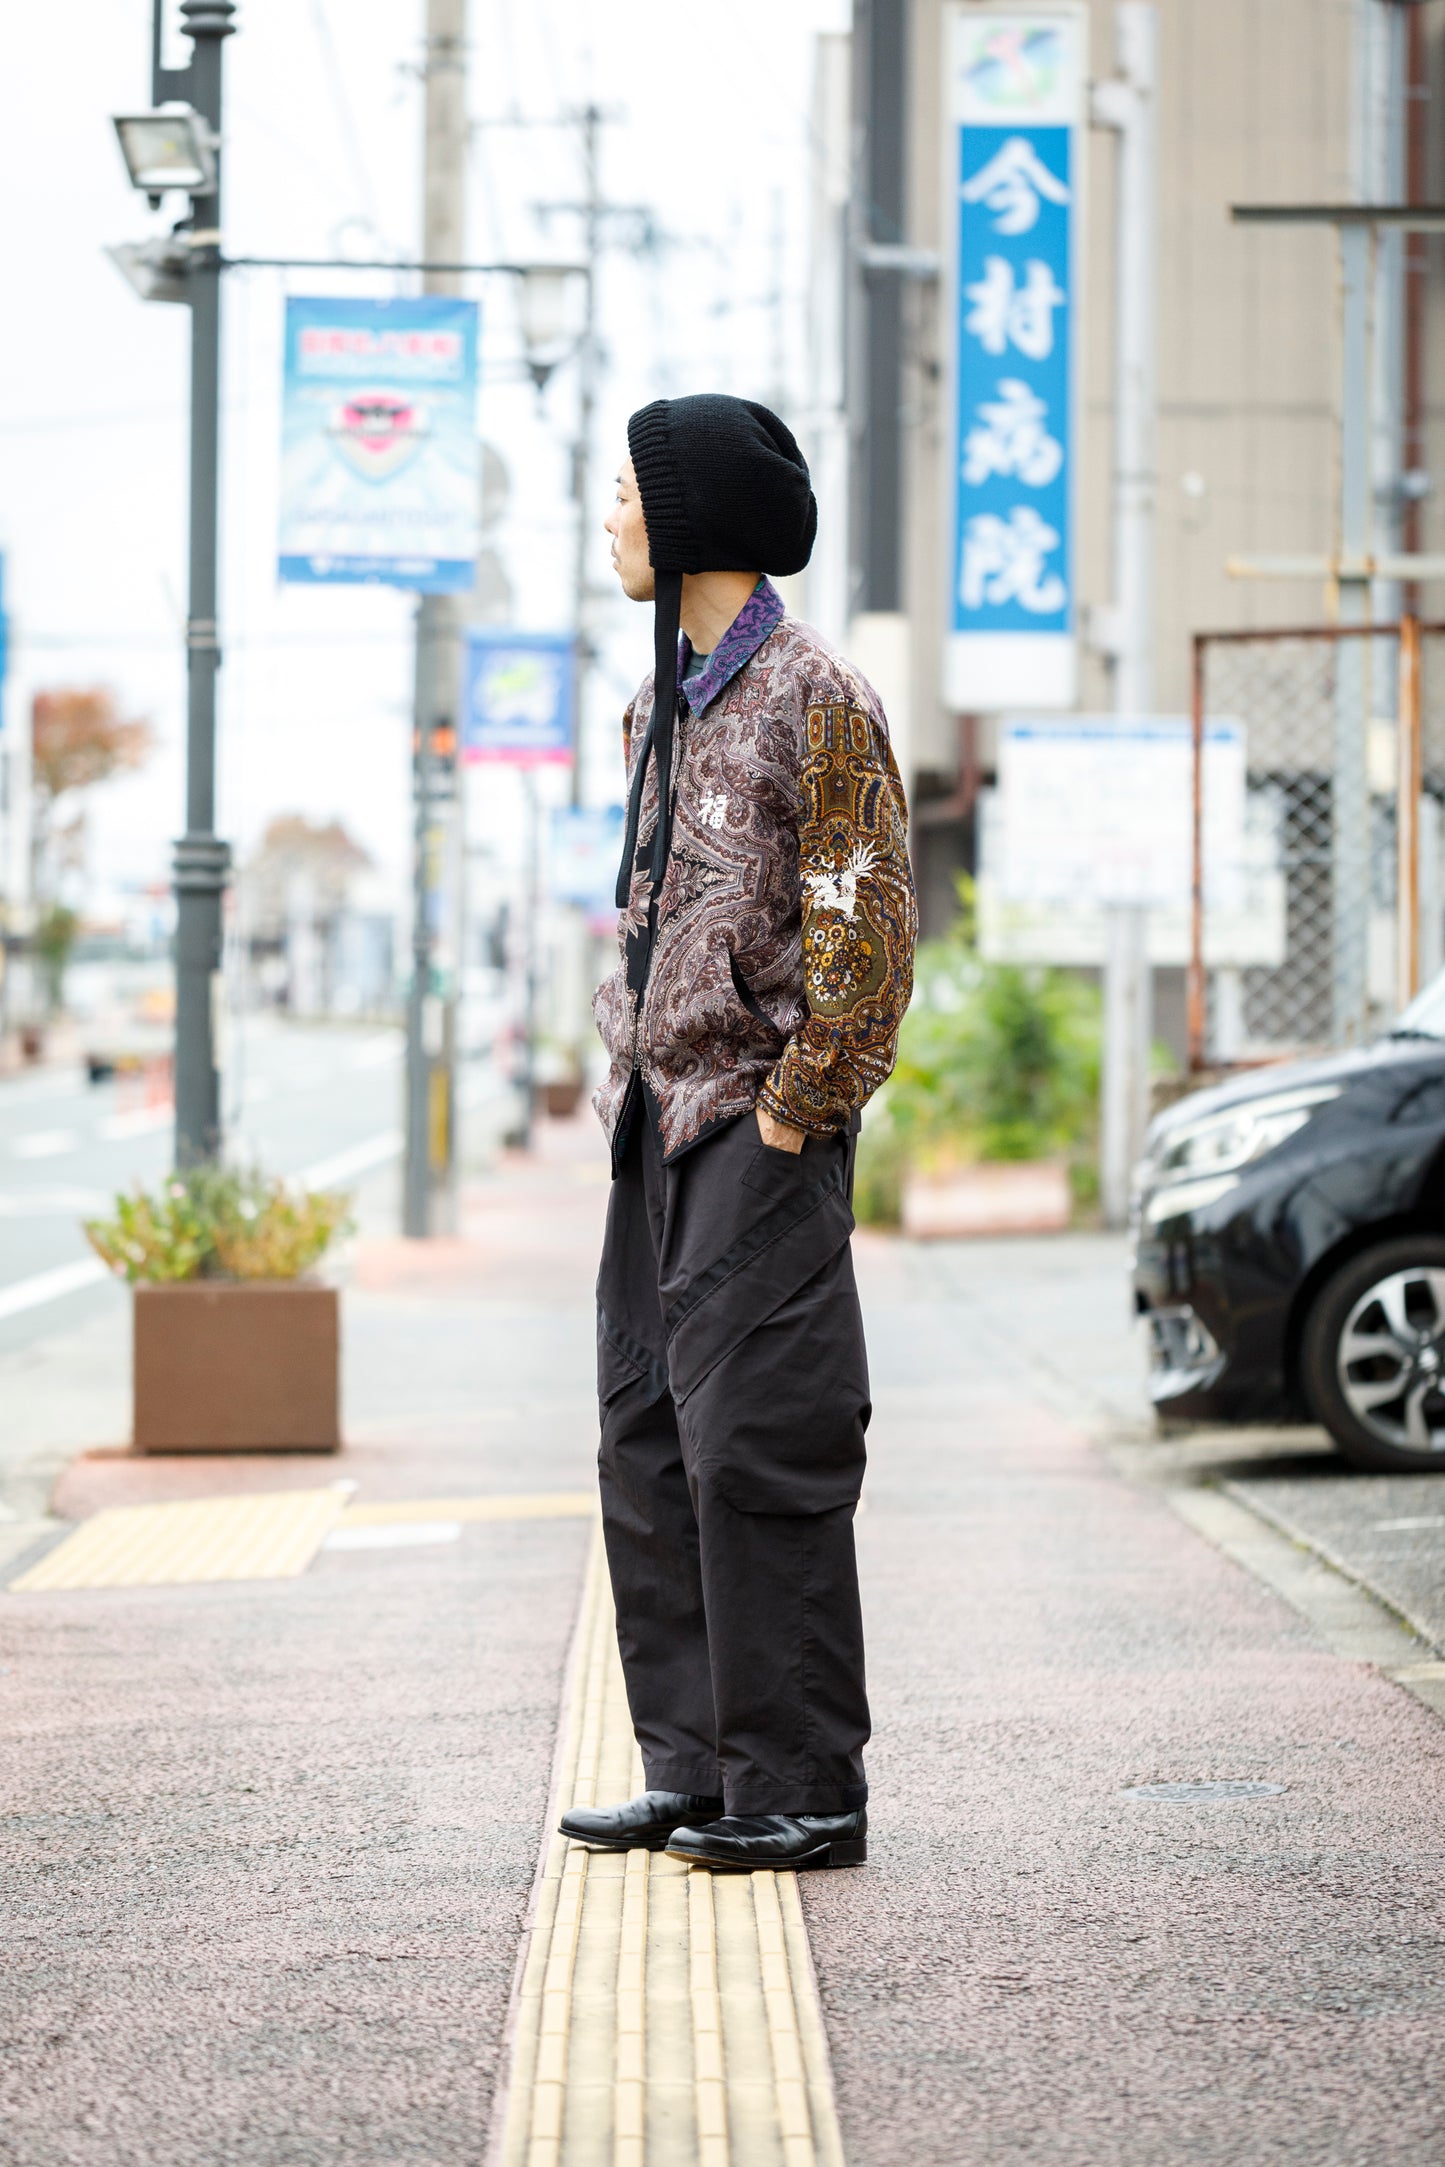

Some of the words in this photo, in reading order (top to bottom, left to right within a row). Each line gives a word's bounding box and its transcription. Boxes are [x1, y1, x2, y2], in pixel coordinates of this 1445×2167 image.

[962, 136, 1070, 614] 今村病院
[697, 790, 727, 829] 福
